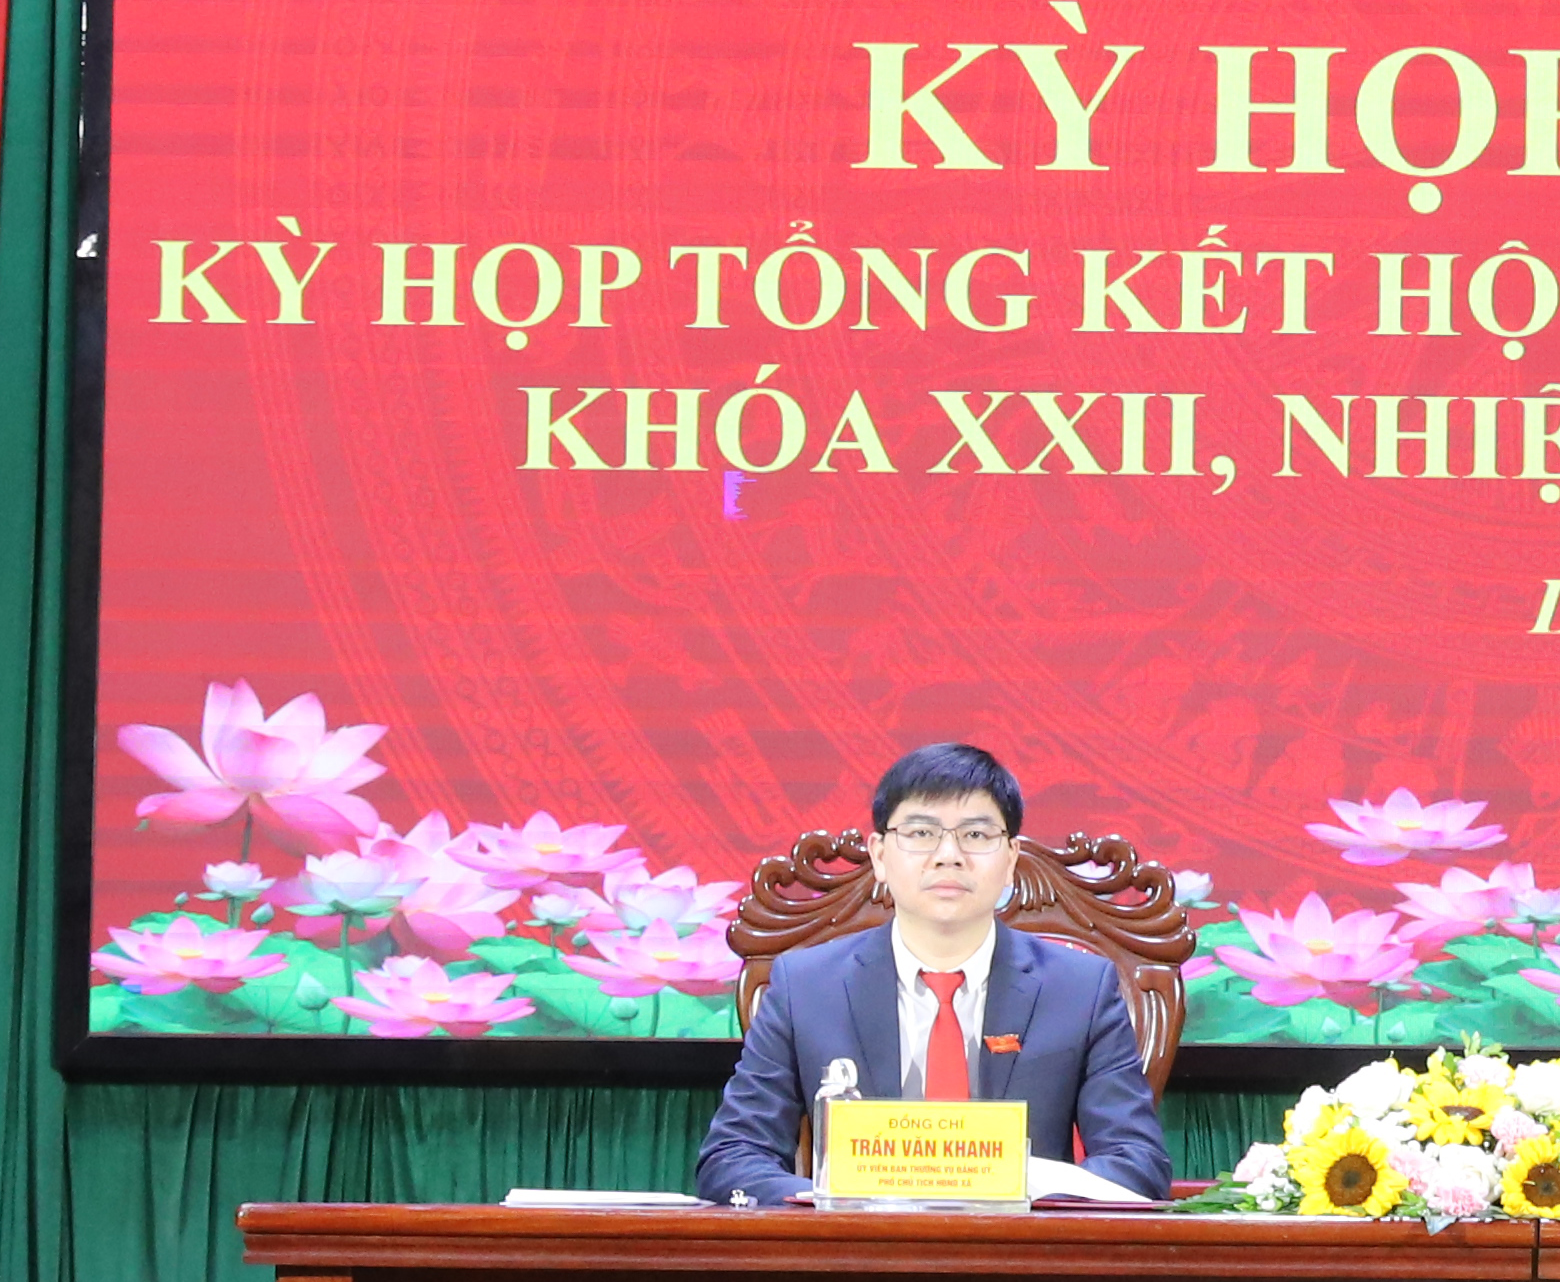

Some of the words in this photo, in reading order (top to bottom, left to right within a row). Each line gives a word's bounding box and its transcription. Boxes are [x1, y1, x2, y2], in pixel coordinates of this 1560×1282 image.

[850, 0, 1145, 171] KỲ
[149, 215, 337, 325] KỲ
[371, 242, 642, 351] HỌP
[669, 220, 1037, 333] TỔNG
[1072, 224, 1334, 334] KẾT
[516, 363, 899, 473] KHÓA
[926, 391, 1236, 496] XXII,
[902, 1136, 937, 1157] VĂN
[943, 1140, 1004, 1159] KHANH
